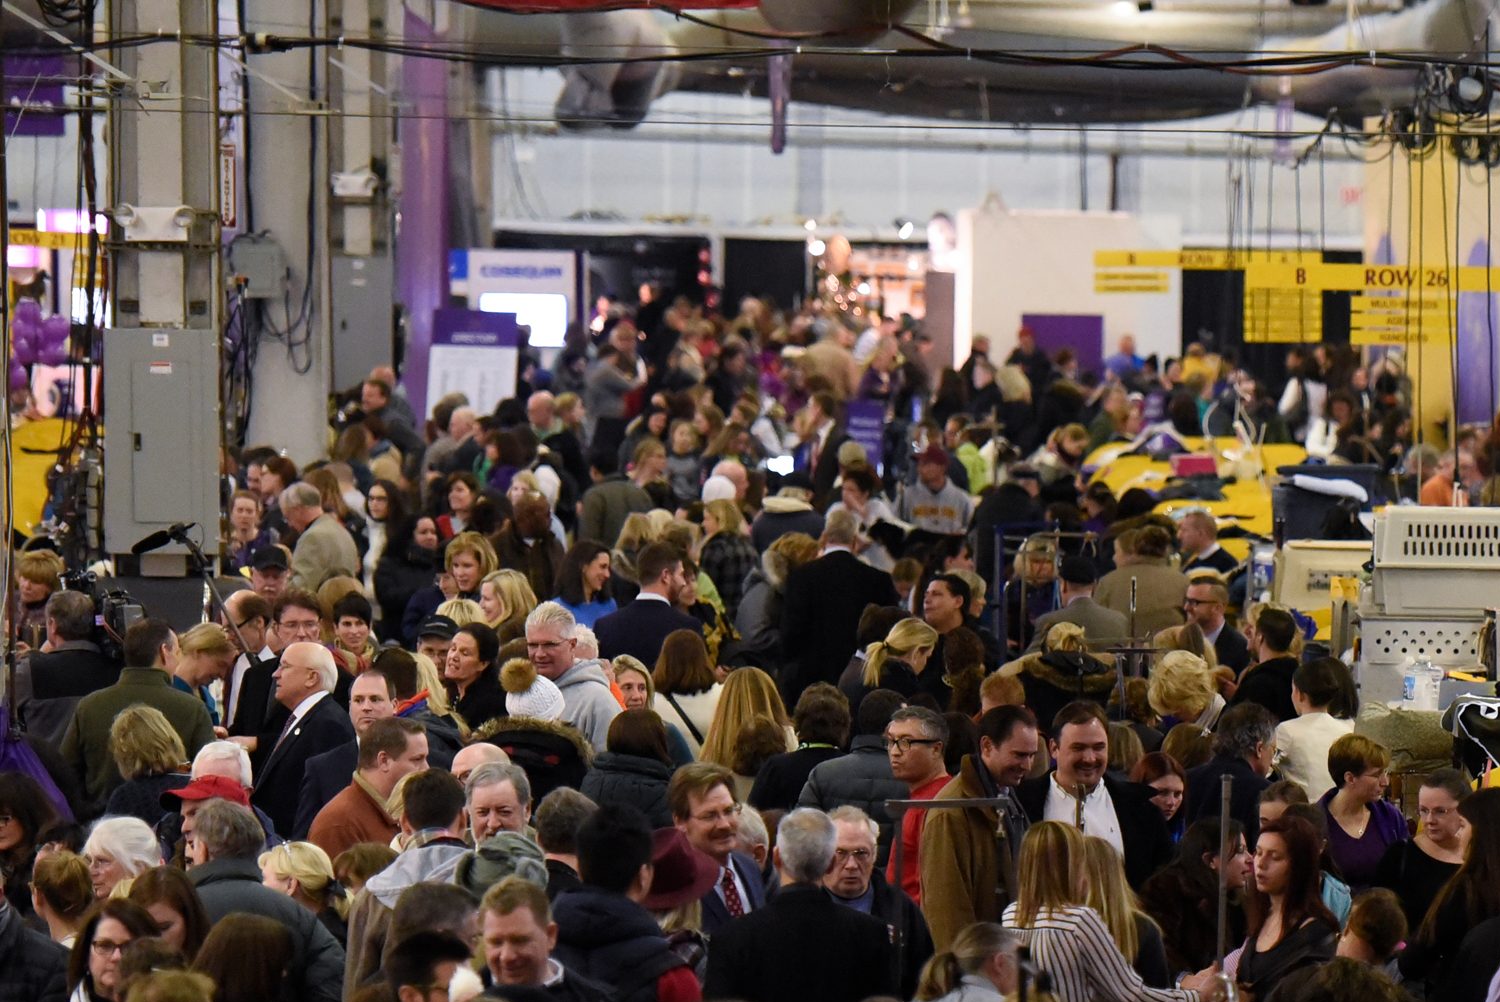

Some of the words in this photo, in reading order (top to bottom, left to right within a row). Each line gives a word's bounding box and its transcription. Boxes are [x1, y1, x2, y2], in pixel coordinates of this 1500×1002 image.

[1295, 267, 1307, 285] B
[1364, 268, 1417, 287] ROW
[1426, 270, 1449, 288] 26
